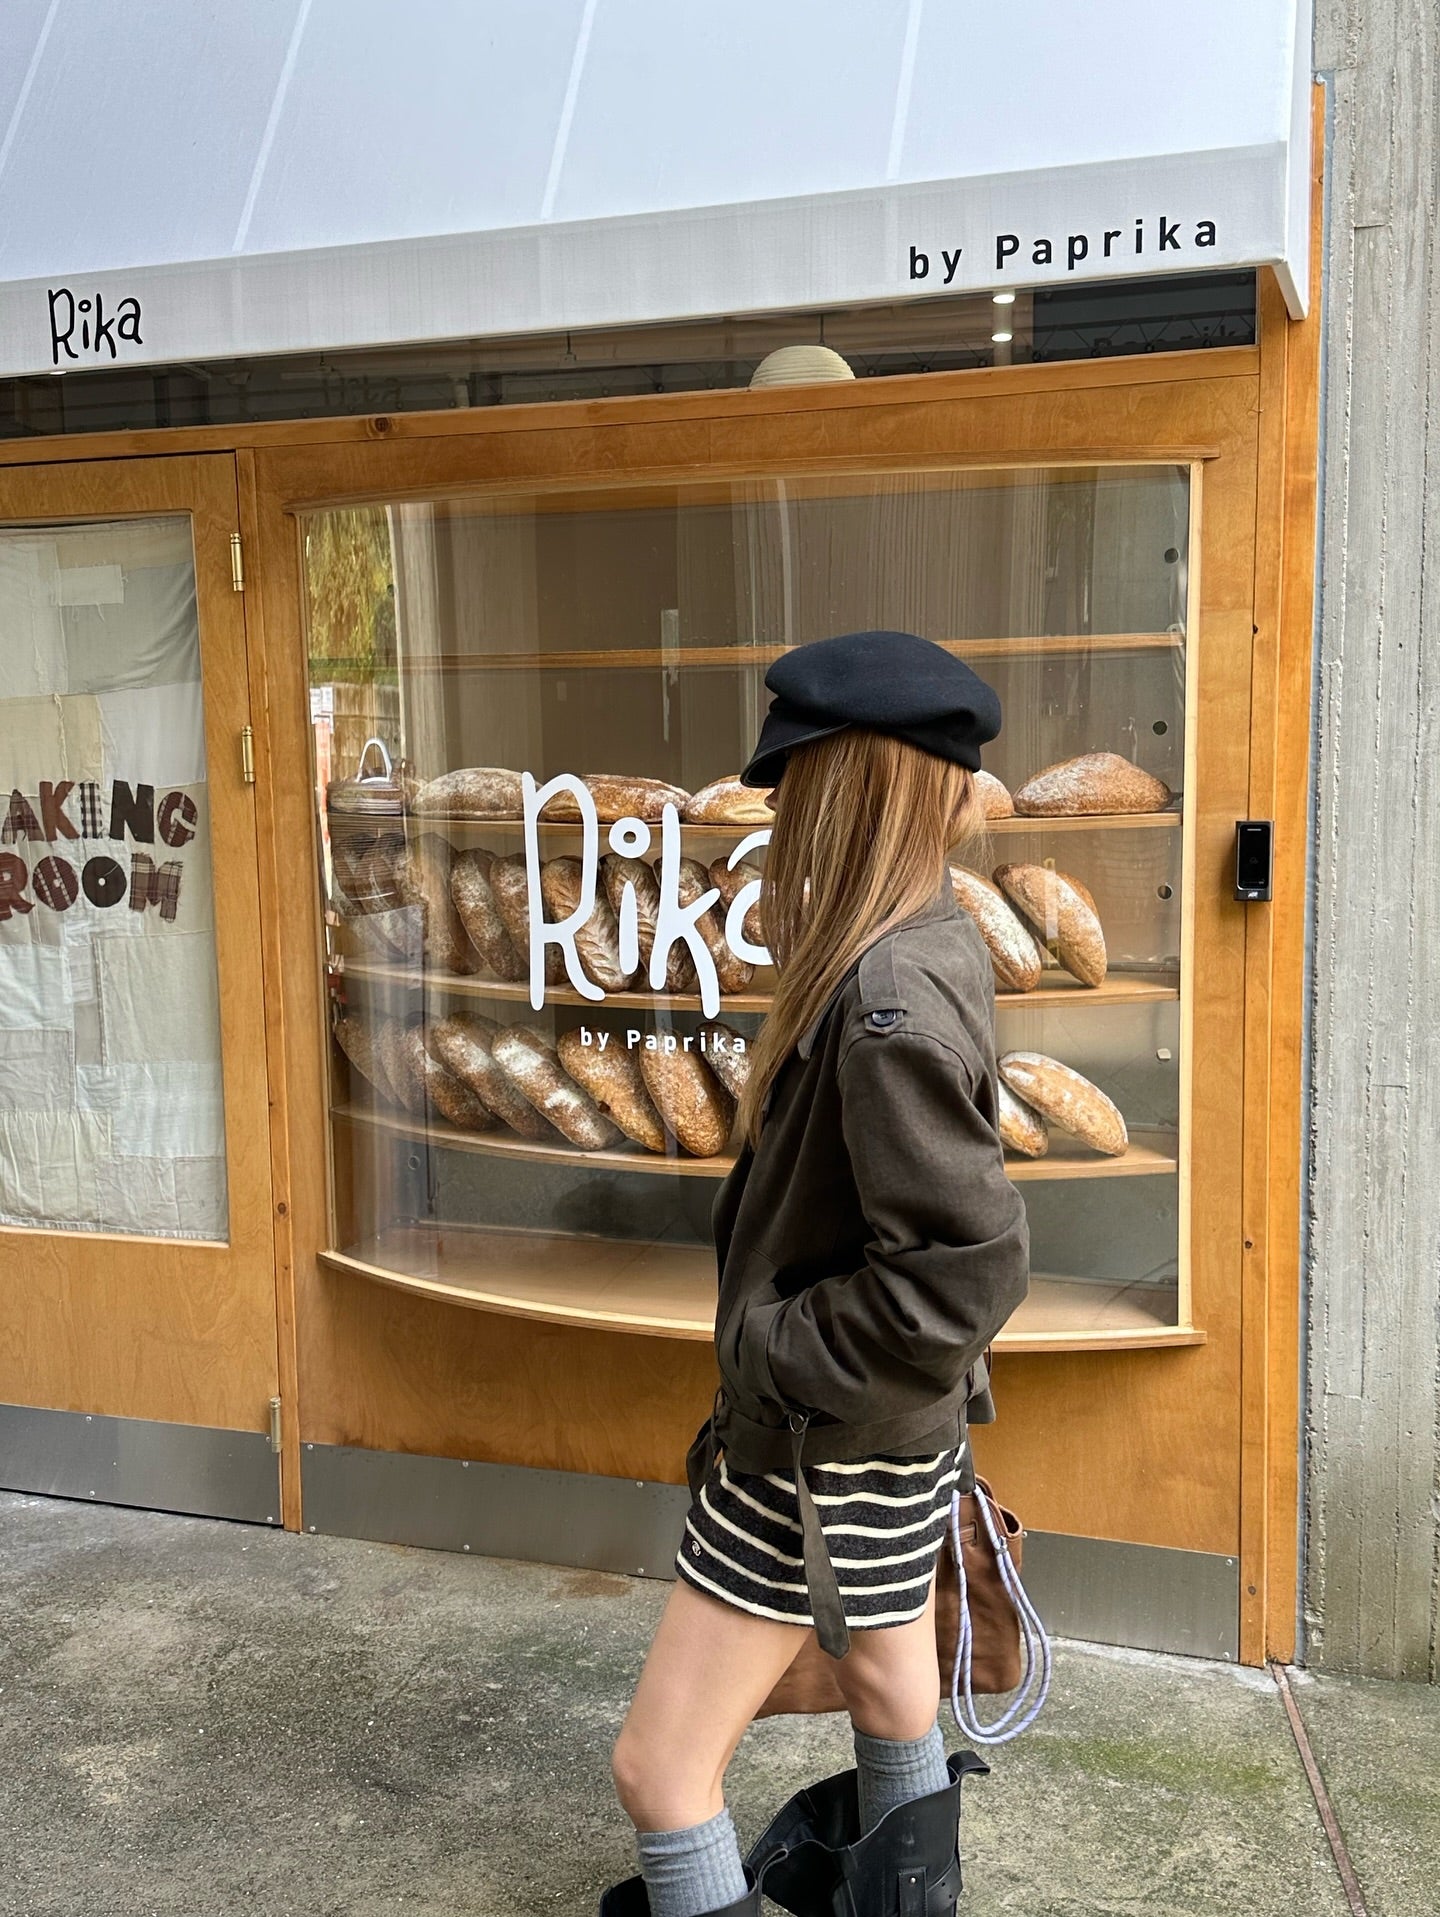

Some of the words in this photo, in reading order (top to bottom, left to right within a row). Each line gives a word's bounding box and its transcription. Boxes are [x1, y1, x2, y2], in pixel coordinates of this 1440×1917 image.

[909, 246, 963, 285] by
[996, 216, 1217, 271] Paprika
[47, 288, 143, 365] Rika
[0, 852, 183, 923] ROOM
[580, 1026, 610, 1052] by
[626, 1029, 746, 1056] Paprika
